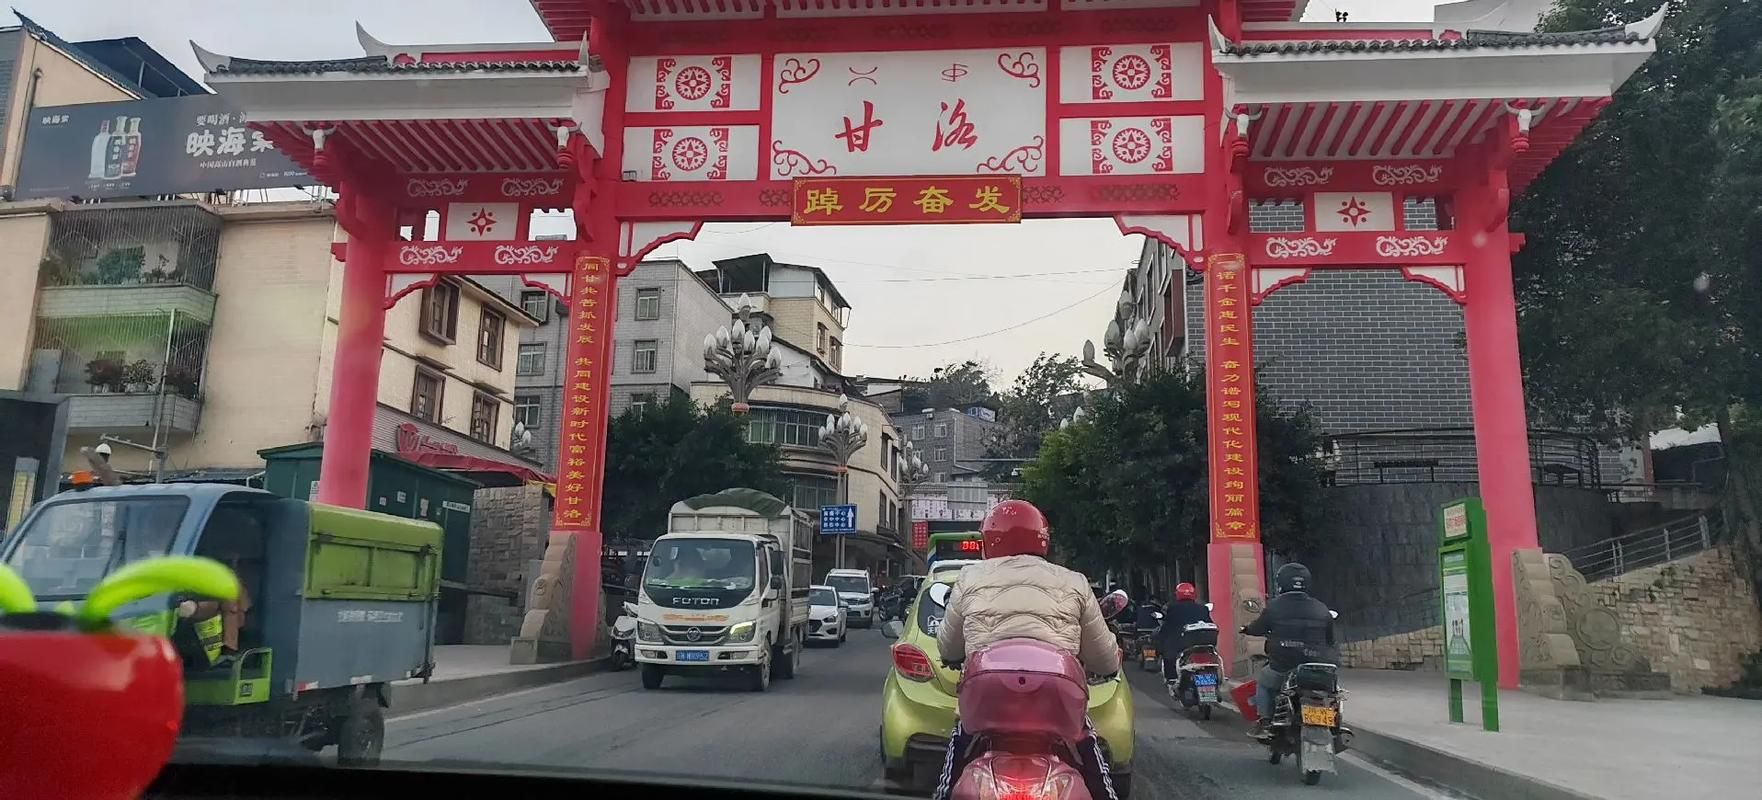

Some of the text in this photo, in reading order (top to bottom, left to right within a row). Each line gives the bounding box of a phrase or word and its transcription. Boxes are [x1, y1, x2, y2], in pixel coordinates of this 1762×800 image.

[834, 98, 977, 152] 甘洛
[804, 185, 1010, 214] 踔厉奋发
[563, 262, 599, 520] 同甘共苦抓发展 共同建设新时代富裕美好甘洛
[1220, 359, 1246, 531] 奋力谱写现代化建设绚丽篇章
[672, 596, 720, 605] FOTON
